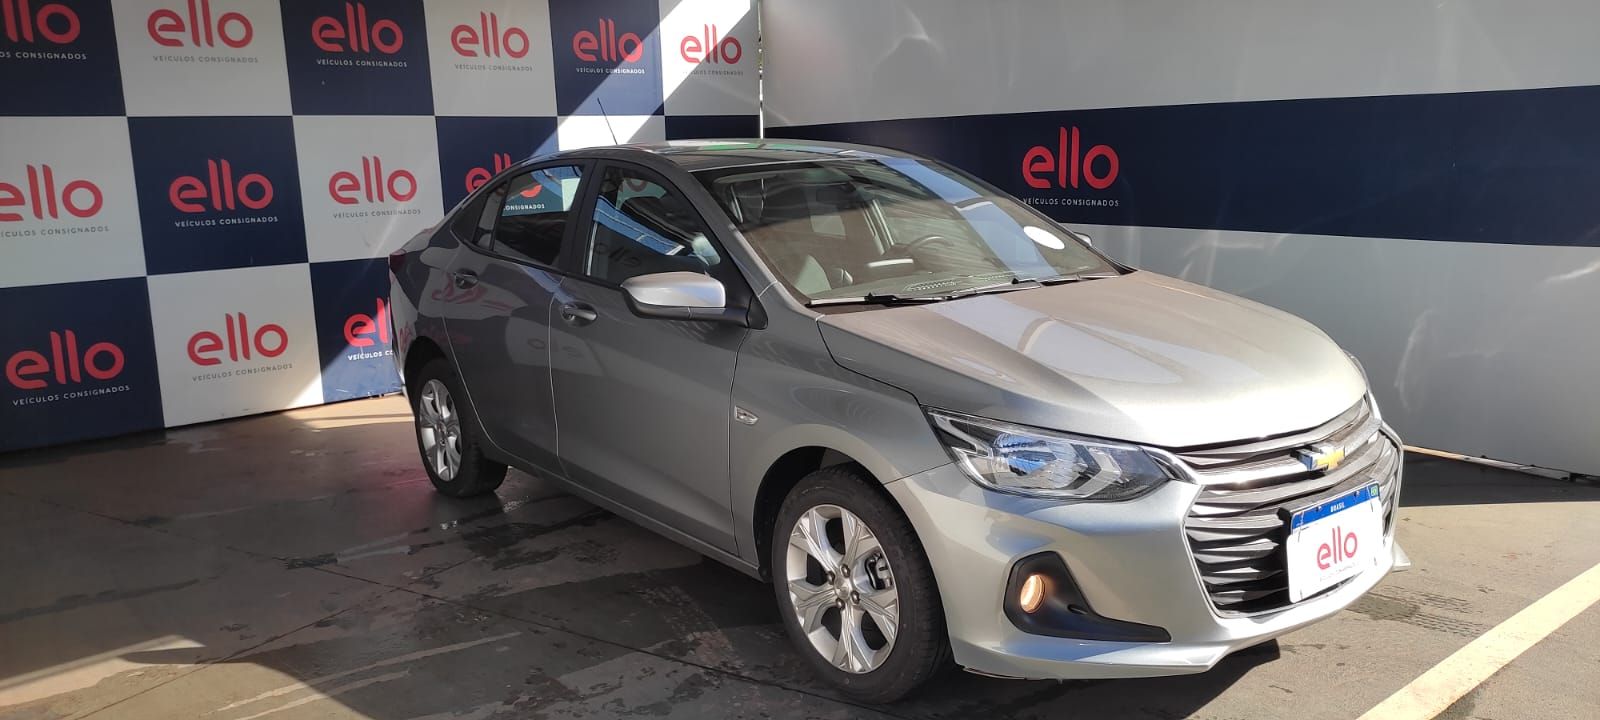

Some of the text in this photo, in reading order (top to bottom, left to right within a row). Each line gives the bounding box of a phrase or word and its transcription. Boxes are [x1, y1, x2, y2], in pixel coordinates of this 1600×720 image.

[147, 0, 254, 48] ello
[311, 2, 404, 54] ello
[450, 11, 530, 59] ello
[572, 18, 644, 63] ello
[680, 23, 742, 64] ello
[15, 51, 87, 60] CONSIGNADOS
[198, 56, 259, 64] CONSIGNADOS
[316, 58, 408, 68] VEÍCULOS CONSIGNADOS
[329, 155, 418, 205] ello
[1022, 126, 1120, 190] ello
[0, 164, 104, 222] ello
[169, 158, 274, 213] ello
[1061, 198, 1120, 207] CONSIGNADOS
[40, 225, 110, 236] CONSIGNADOS
[174, 216, 278, 228] VEÍCULOS CONSIGNADOS
[5, 329, 125, 390] ello
[187, 311, 289, 367] ello
[347, 351, 383, 361] VEÍCULOS
[235, 363, 293, 376] CONSIGNADOS
[12, 384, 131, 406] VEÍCULOS CONSIGNADOS
[1316, 526, 1358, 571] ello
